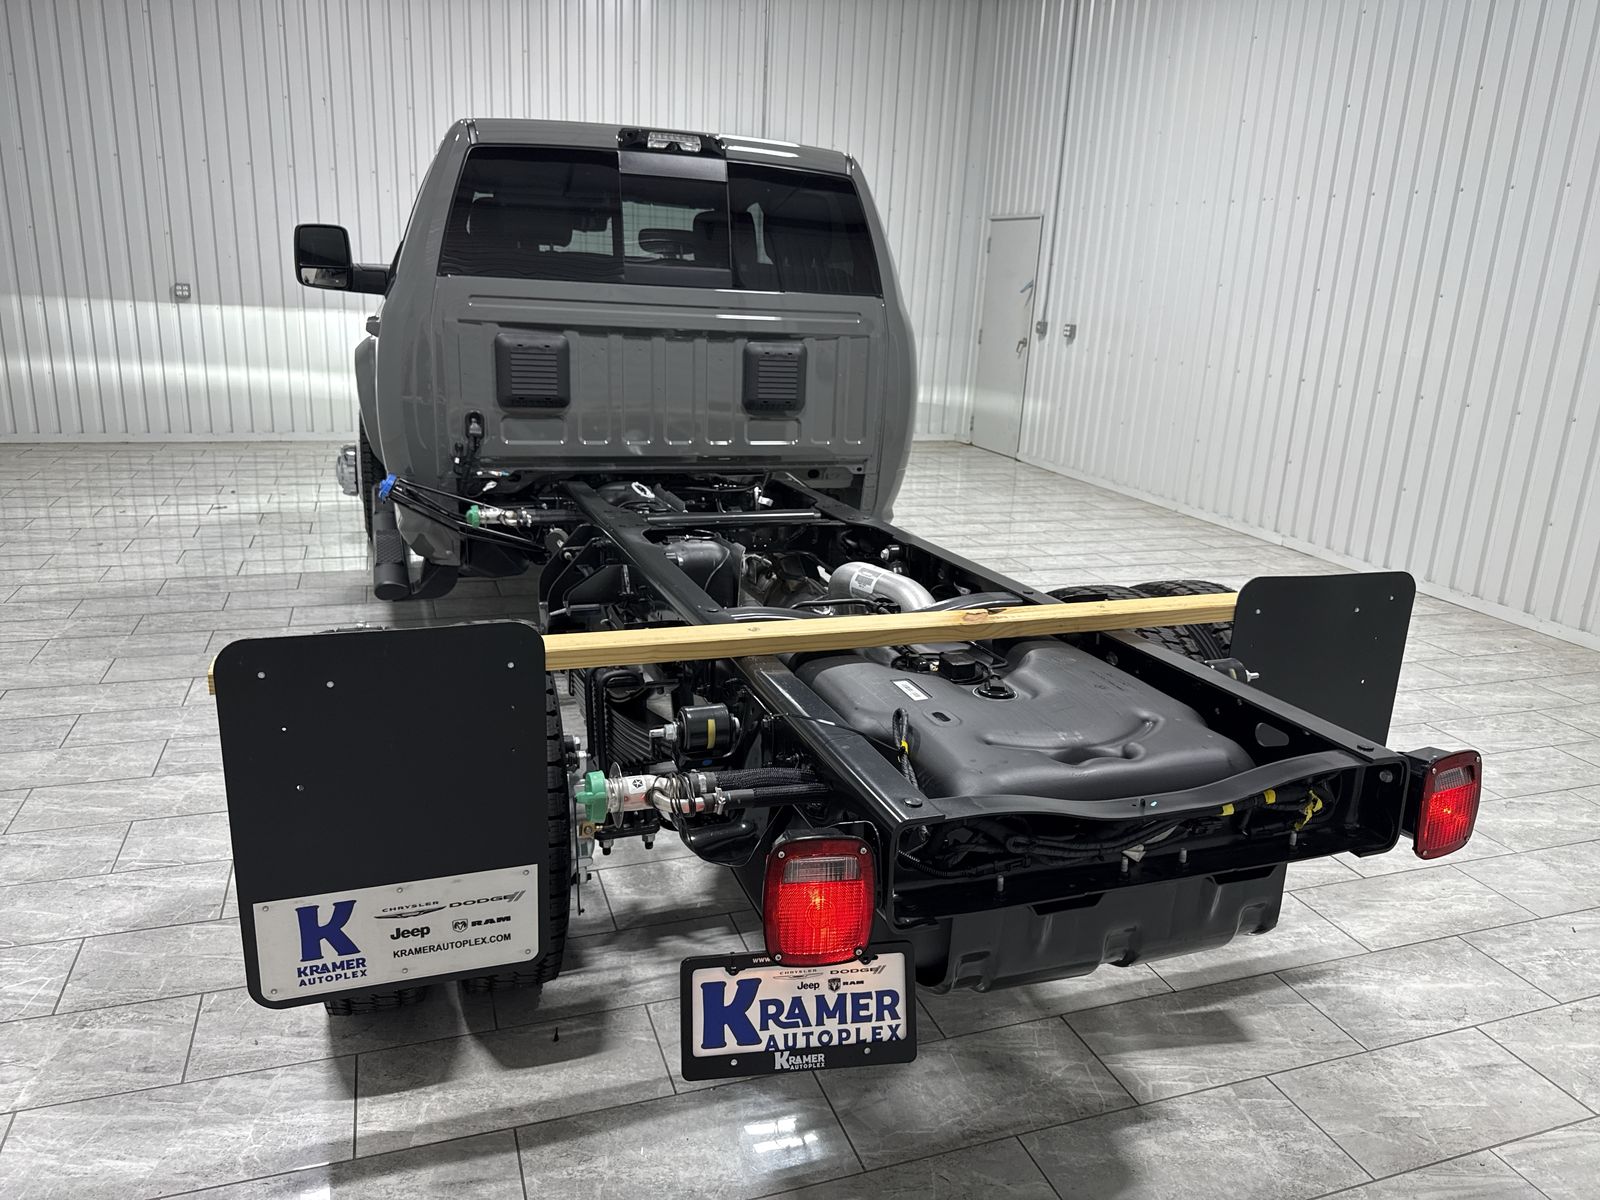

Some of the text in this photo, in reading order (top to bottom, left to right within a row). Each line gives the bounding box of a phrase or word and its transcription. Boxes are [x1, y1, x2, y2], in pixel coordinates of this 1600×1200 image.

[382, 901, 439, 913] CHRYSLER
[449, 894, 517, 908] DODGE
[471, 915, 512, 927] RAM
[295, 899, 361, 962] K
[390, 925, 431, 940] Jeep
[393, 933, 512, 959] KRAMERAUTOPLEX.COM
[296, 957, 367, 978] KRAMER
[829, 967, 878, 975] DODGE
[298, 969, 367, 987] AUTOPLEX
[797, 981, 820, 991] Jeep
[700, 977, 902, 1050] KRAMER
[764, 1023, 902, 1052] AUTOPLEX
[774, 1050, 825, 1070] KRAMER
[790, 1062, 825, 1070] AUTOPLEX
